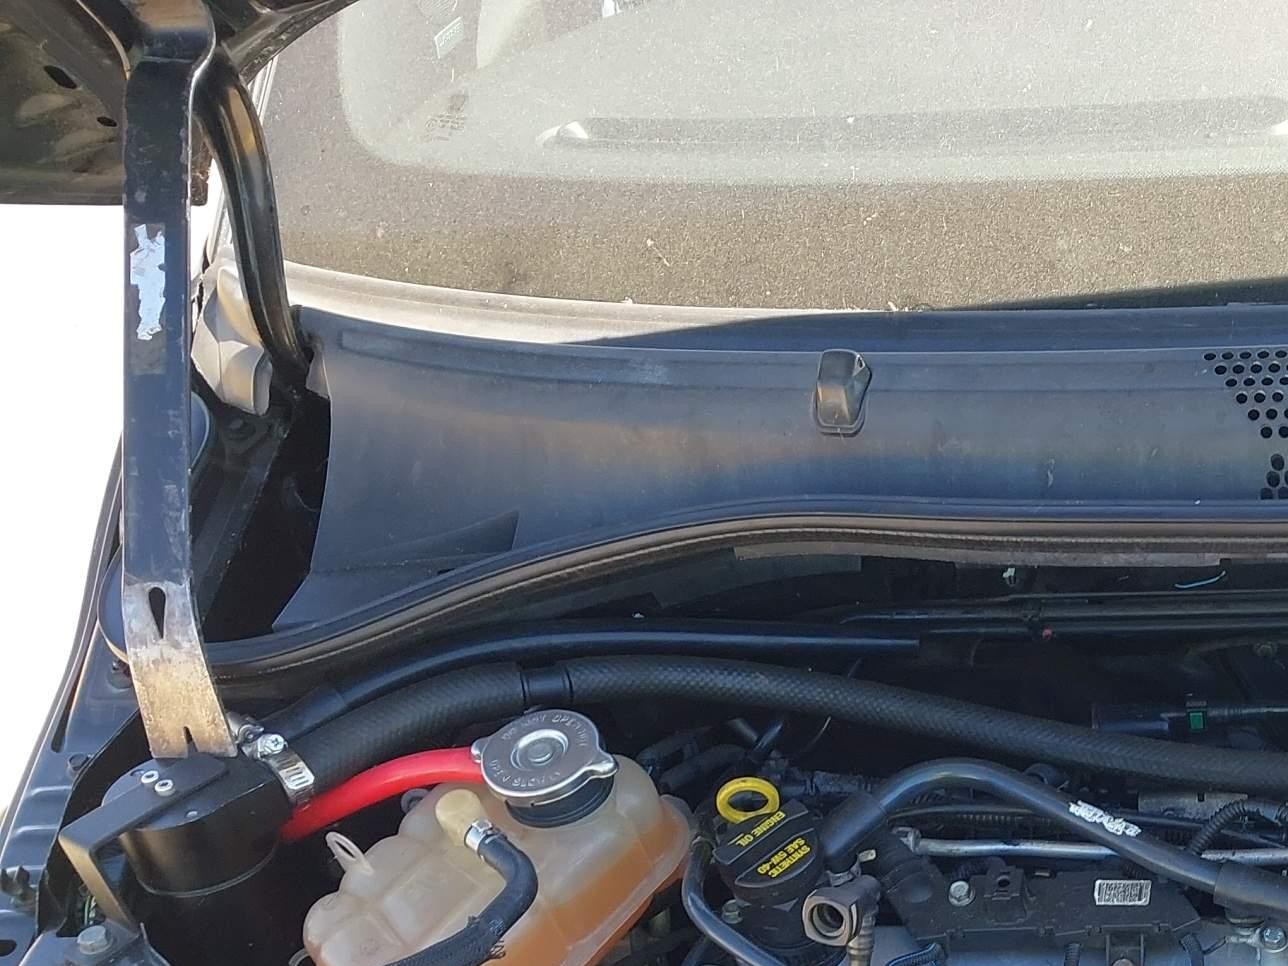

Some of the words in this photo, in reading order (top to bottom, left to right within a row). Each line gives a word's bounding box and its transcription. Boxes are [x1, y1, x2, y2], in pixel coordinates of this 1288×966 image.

[751, 811, 786, 837] ENGINE
[735, 834, 754, 848] OIL
[784, 837, 806, 855] SAE
[756, 851, 787, 874] 5W-40
[768, 846, 811, 878] SYNTHETIC
